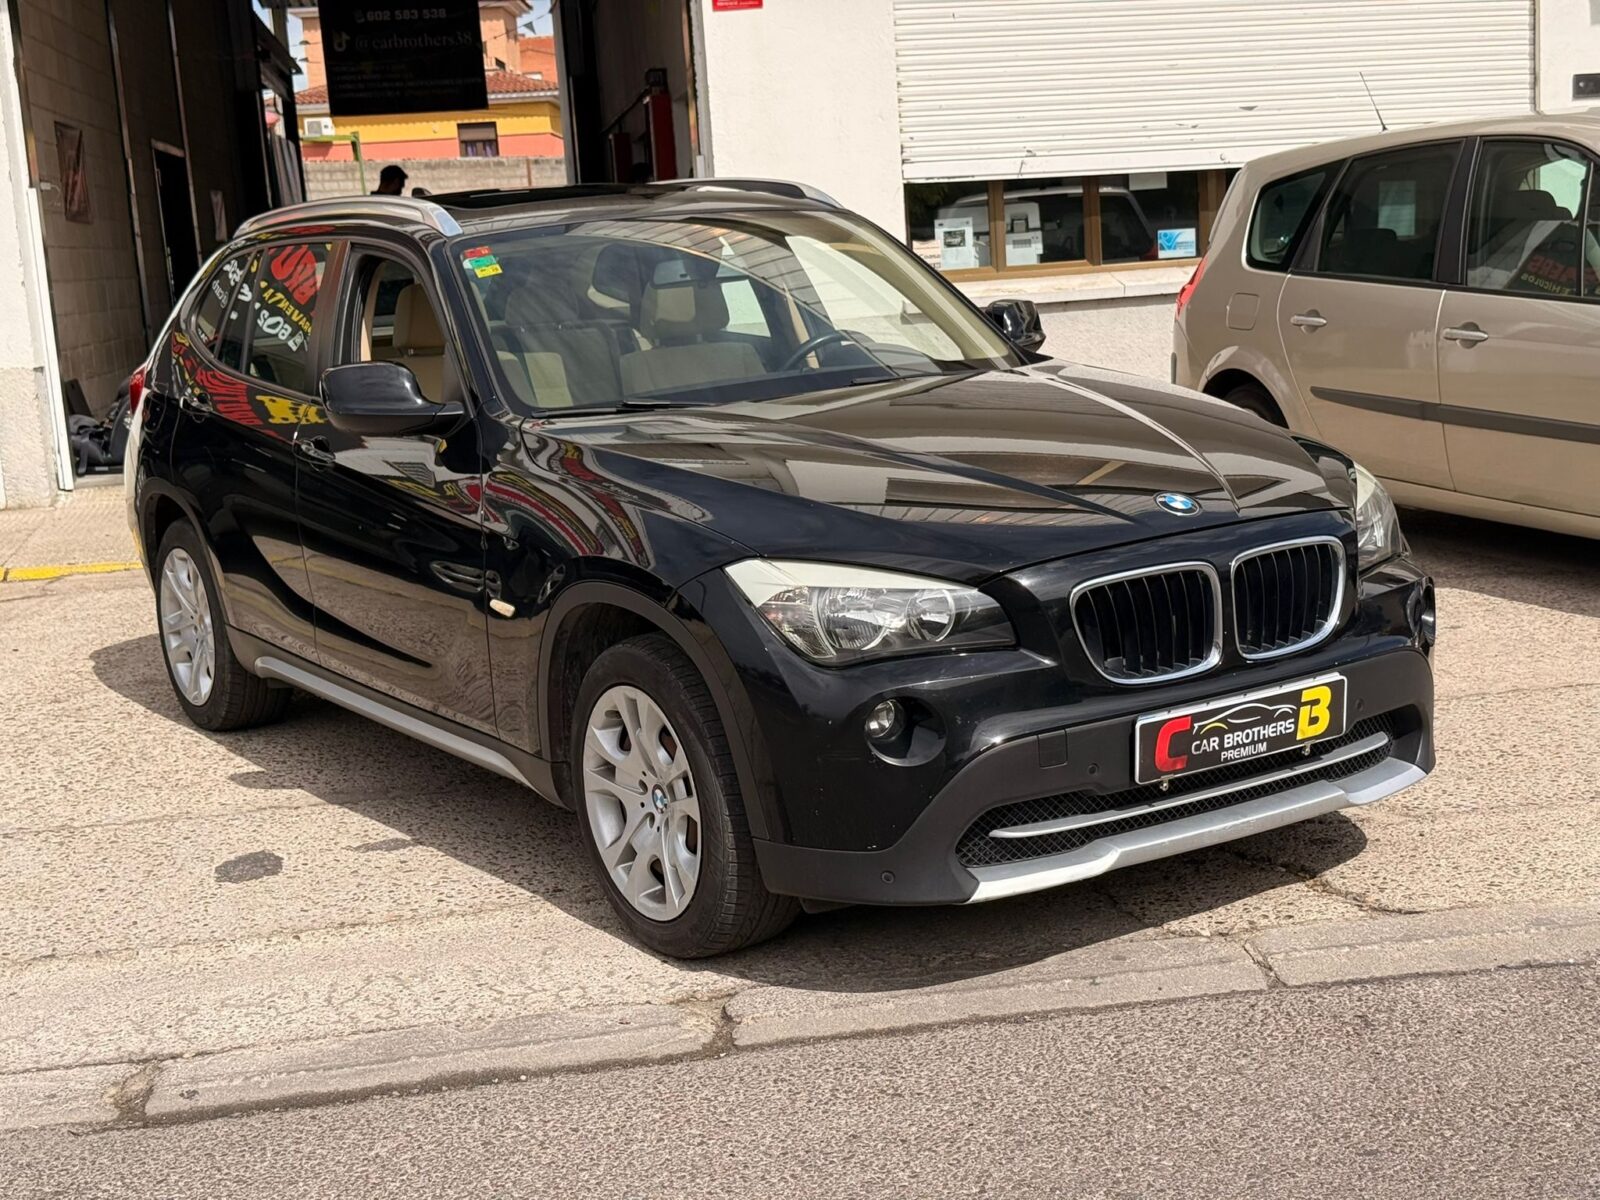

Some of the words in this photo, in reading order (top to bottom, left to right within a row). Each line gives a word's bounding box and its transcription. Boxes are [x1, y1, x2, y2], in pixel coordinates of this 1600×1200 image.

[366, 10, 391, 21] 602
[394, 9, 418, 20] 583
[422, 8, 447, 19] 538
[1154, 715, 1192, 772] C
[1191, 736, 1219, 755] CAR
[1223, 718, 1295, 748] BROTHERS
[1221, 742, 1267, 762] PREMIUM
